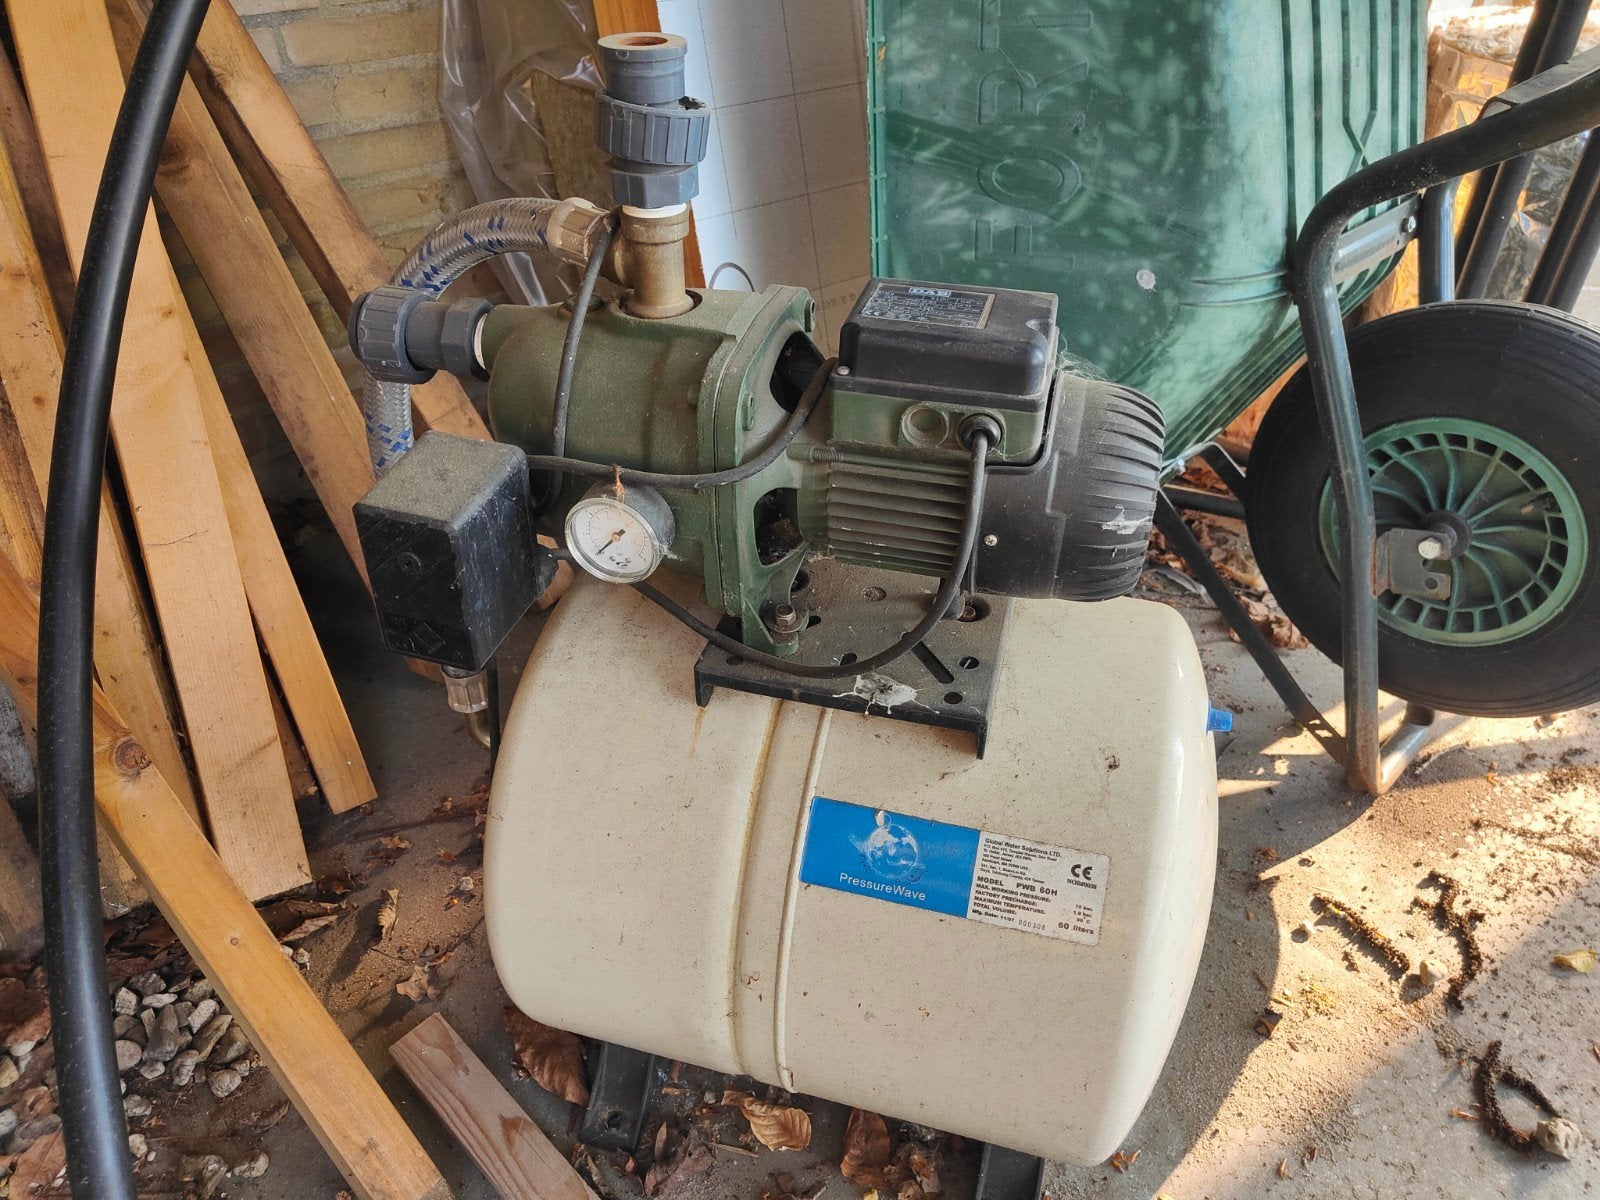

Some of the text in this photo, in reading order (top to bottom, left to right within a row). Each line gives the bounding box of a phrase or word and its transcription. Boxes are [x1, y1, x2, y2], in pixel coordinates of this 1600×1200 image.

[984, 837, 1003, 846] Global
[1021, 845, 1047, 855] Solutions
[1069, 862, 1093, 880] CE
[839, 872, 926, 901] PressureWave
[976, 875, 1057, 895] MODEL PWB 60H
[973, 895, 1001, 905] MAXIMUM
[974, 889, 1037, 906] FACTORY PRECHARGE:
[991, 886, 1018, 895] WORKING
[1019, 892, 1051, 902] PRESSURE:
[991, 905, 1017, 915] VOLUME:
[1057, 921, 1094, 934] 60 liters
